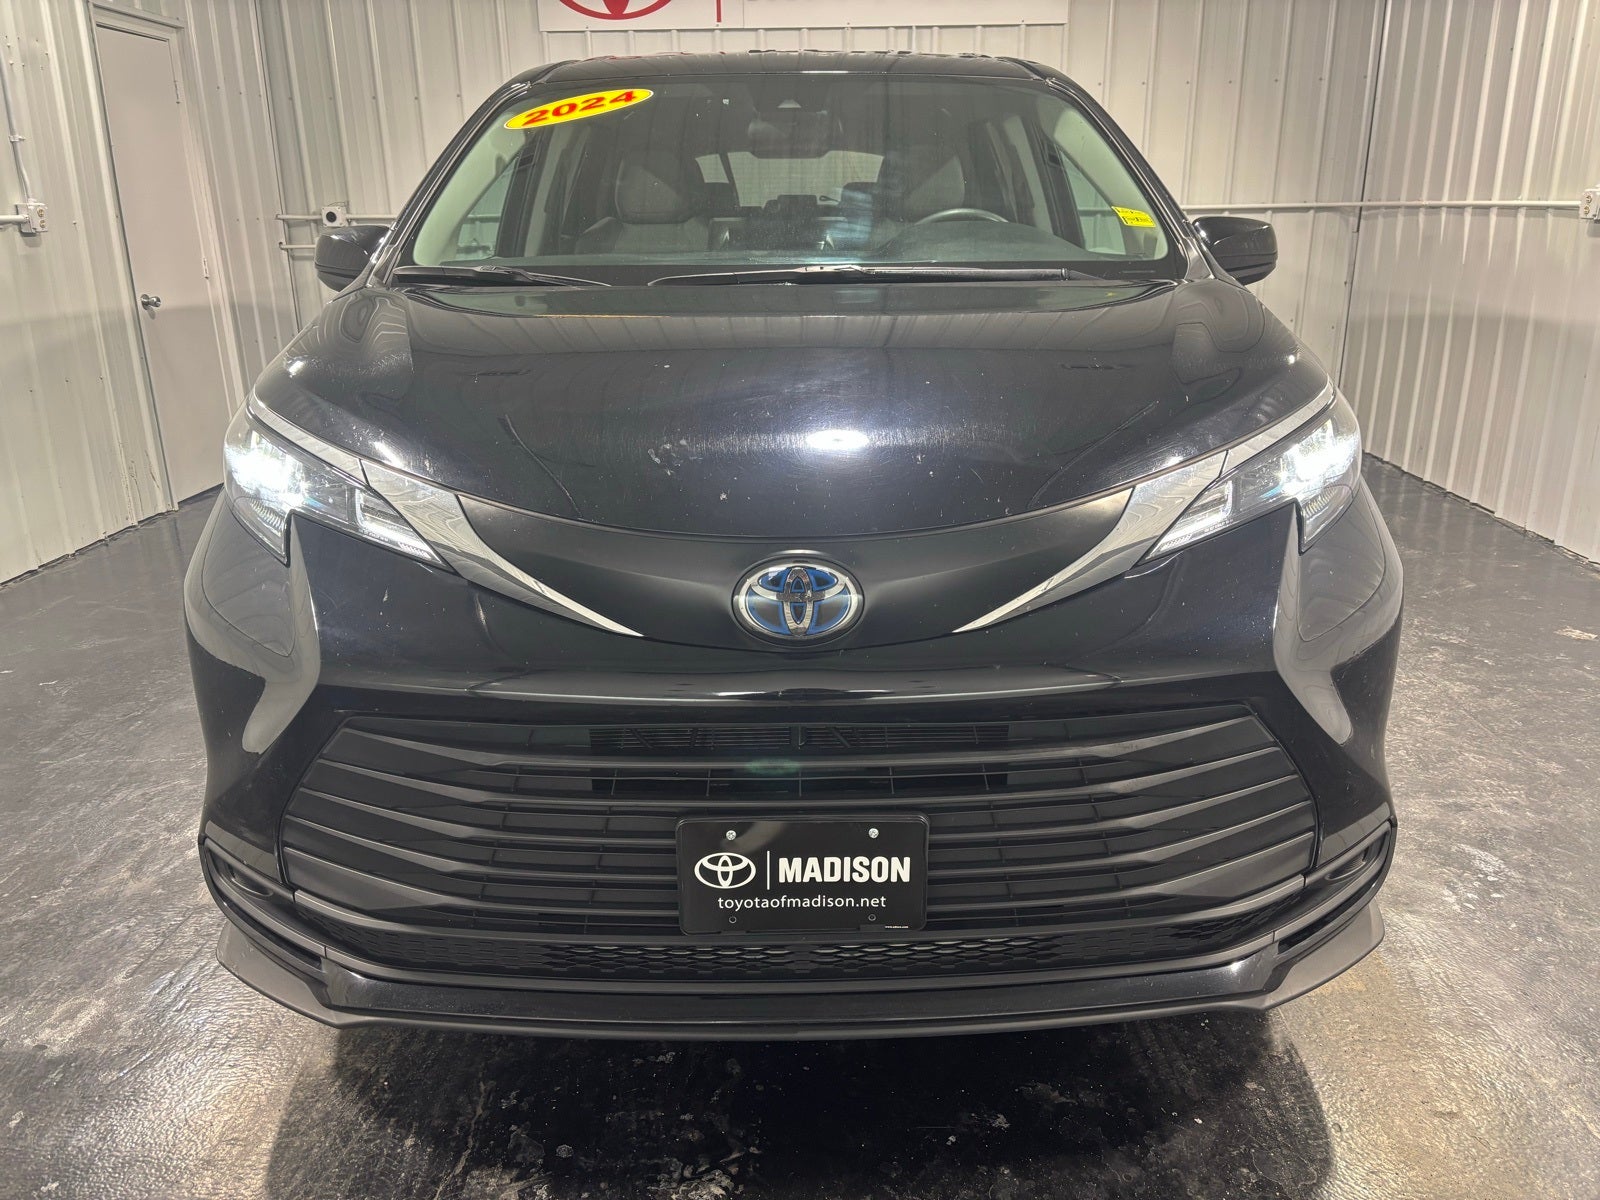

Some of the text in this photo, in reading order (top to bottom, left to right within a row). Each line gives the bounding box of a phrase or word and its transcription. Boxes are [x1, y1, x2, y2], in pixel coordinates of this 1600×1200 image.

[523, 91, 636, 126] 2024
[778, 856, 911, 883] MADISON
[717, 895, 887, 912] toyotaofmadison.net
